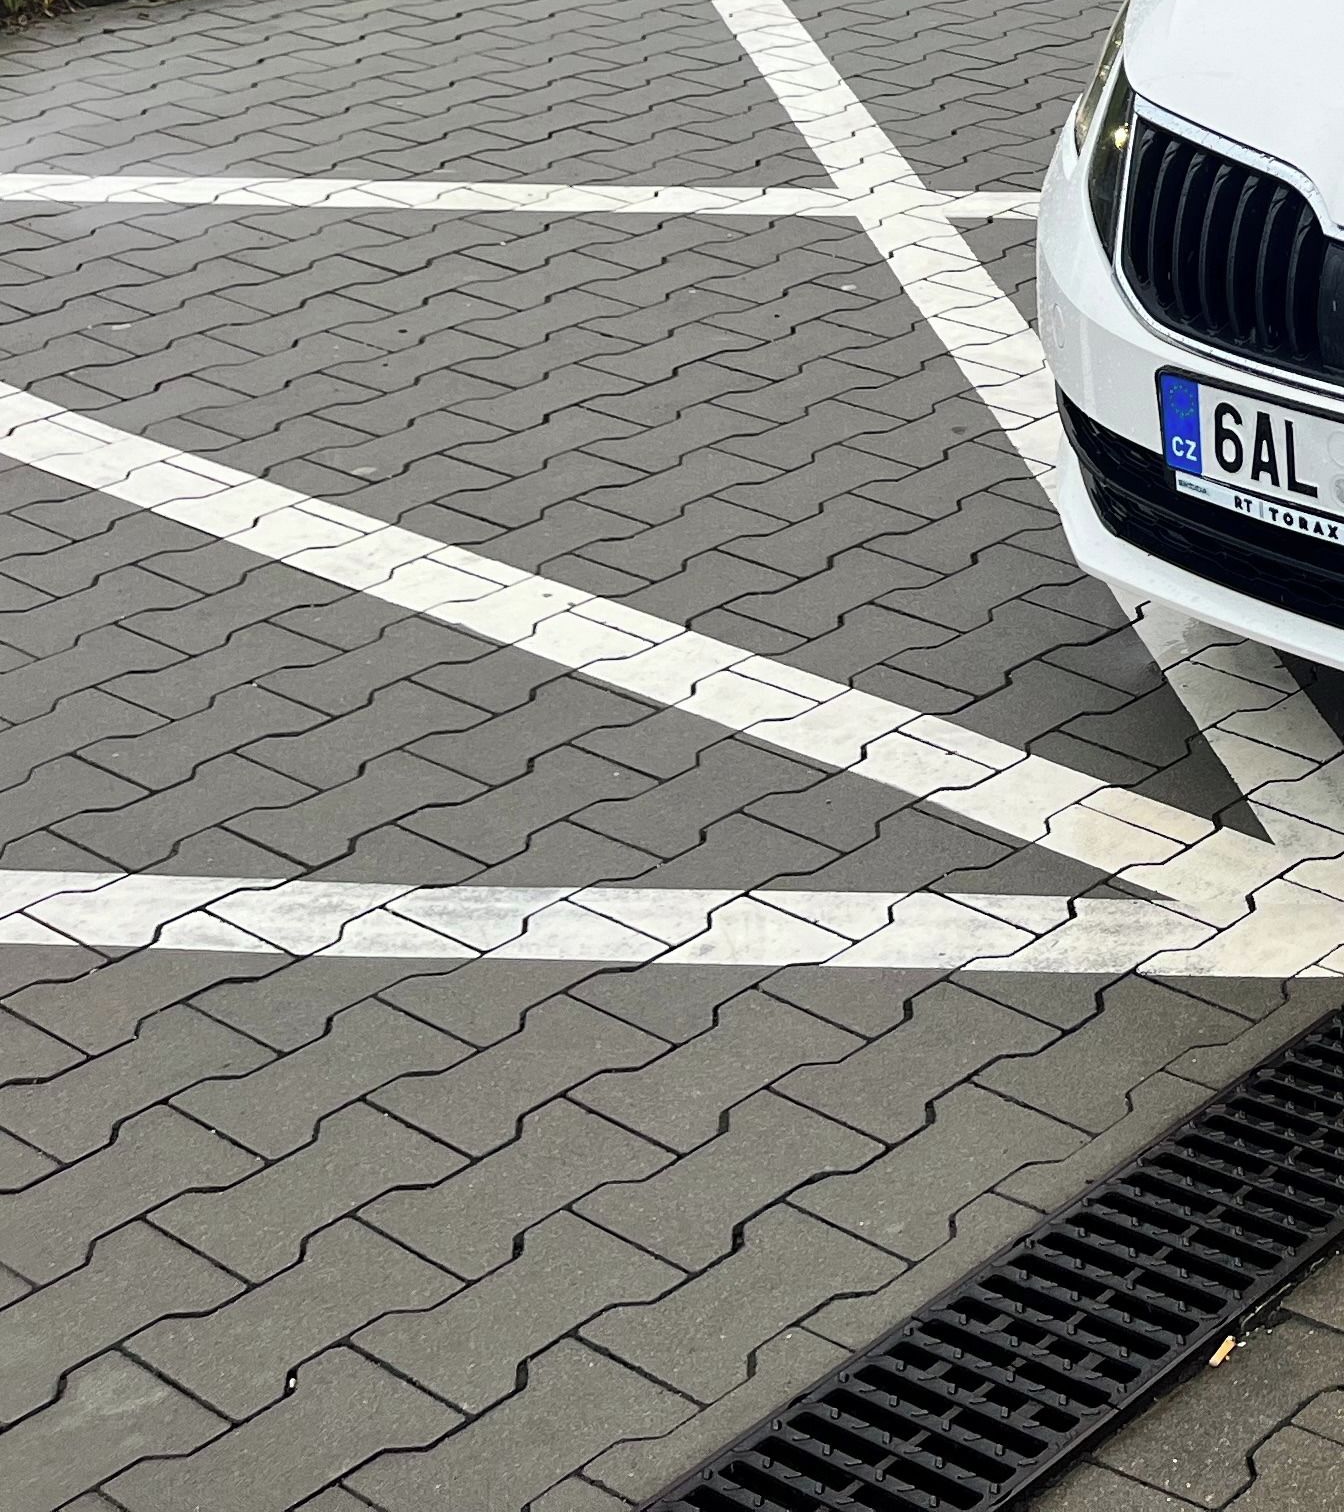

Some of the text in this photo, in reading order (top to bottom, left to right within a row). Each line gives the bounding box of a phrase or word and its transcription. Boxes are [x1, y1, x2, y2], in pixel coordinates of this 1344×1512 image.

[1171, 435, 1198, 461] CZ
[1214, 401, 1318, 499] 6AL
[1234, 495, 1339, 540] RT TORAX
